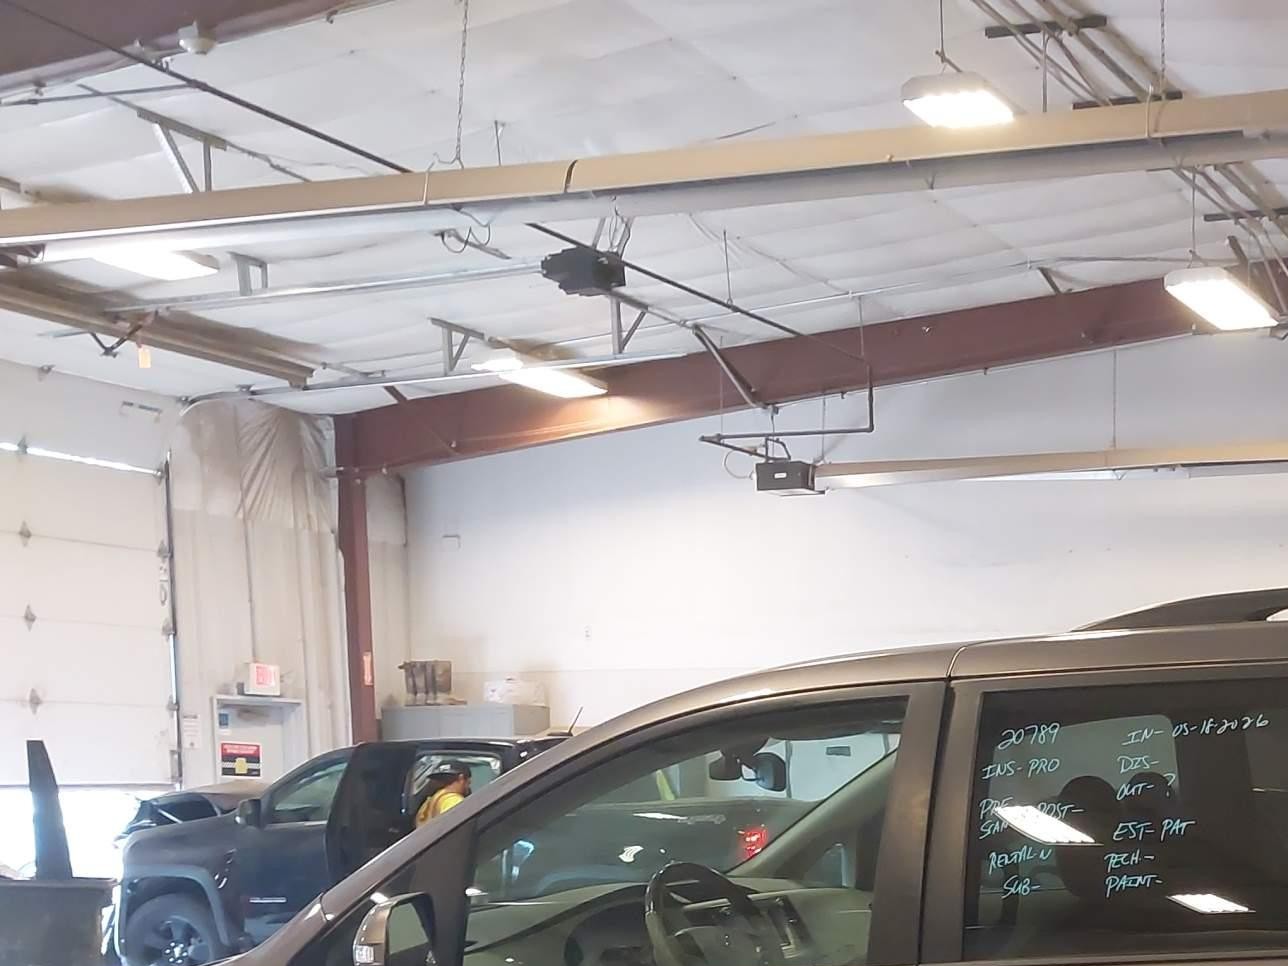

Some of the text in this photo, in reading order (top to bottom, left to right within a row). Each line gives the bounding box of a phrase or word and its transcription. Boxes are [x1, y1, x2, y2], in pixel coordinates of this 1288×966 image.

[998, 722, 1060, 750] 20789
[1121, 727, 1164, 746] IN-
[1027, 758, 1060, 778] PRO
[1160, 818, 1197, 842] PAT
